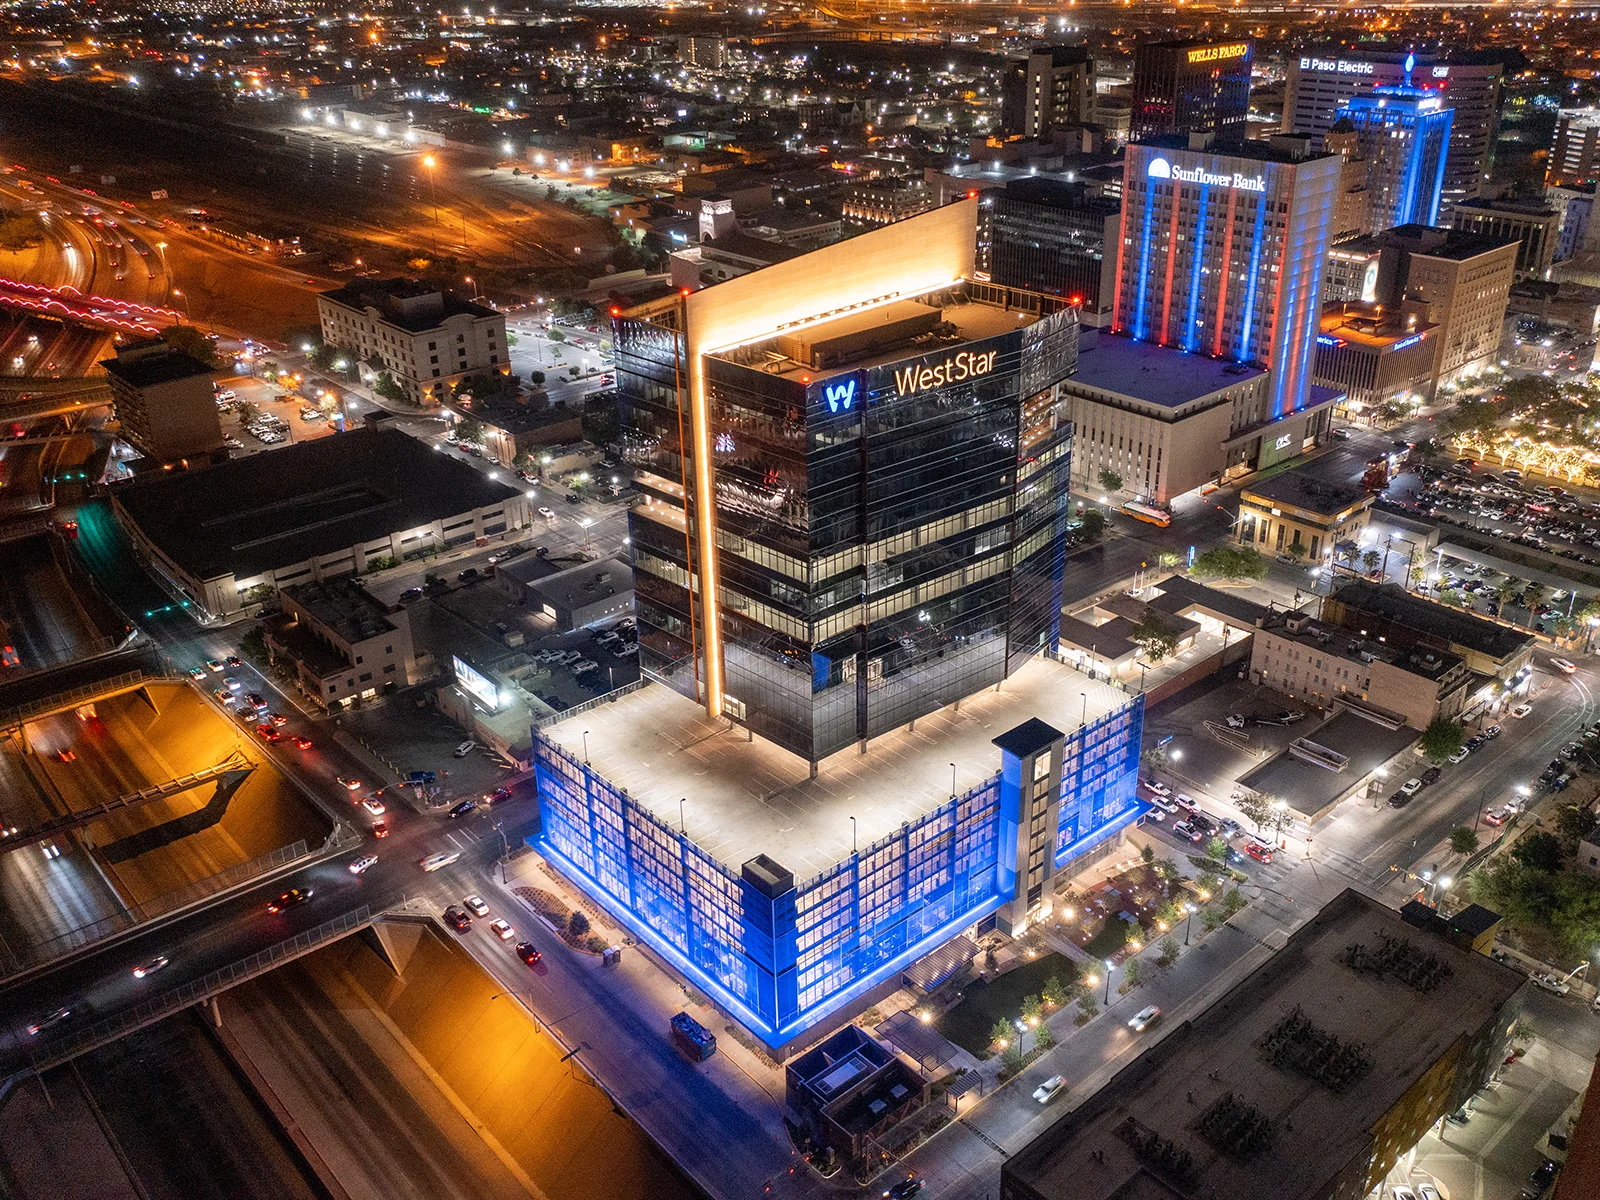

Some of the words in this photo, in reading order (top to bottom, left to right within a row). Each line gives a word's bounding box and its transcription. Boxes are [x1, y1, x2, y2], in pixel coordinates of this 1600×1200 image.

[1188, 48, 1218, 63] WELLS
[1218, 44, 1247, 59] FARGO
[1300, 57, 1310, 70] El
[1311, 58, 1336, 72] Paso
[1337, 60, 1374, 75] Electric
[1171, 164, 1233, 187] Sunflower
[1232, 173, 1266, 192] Bank
